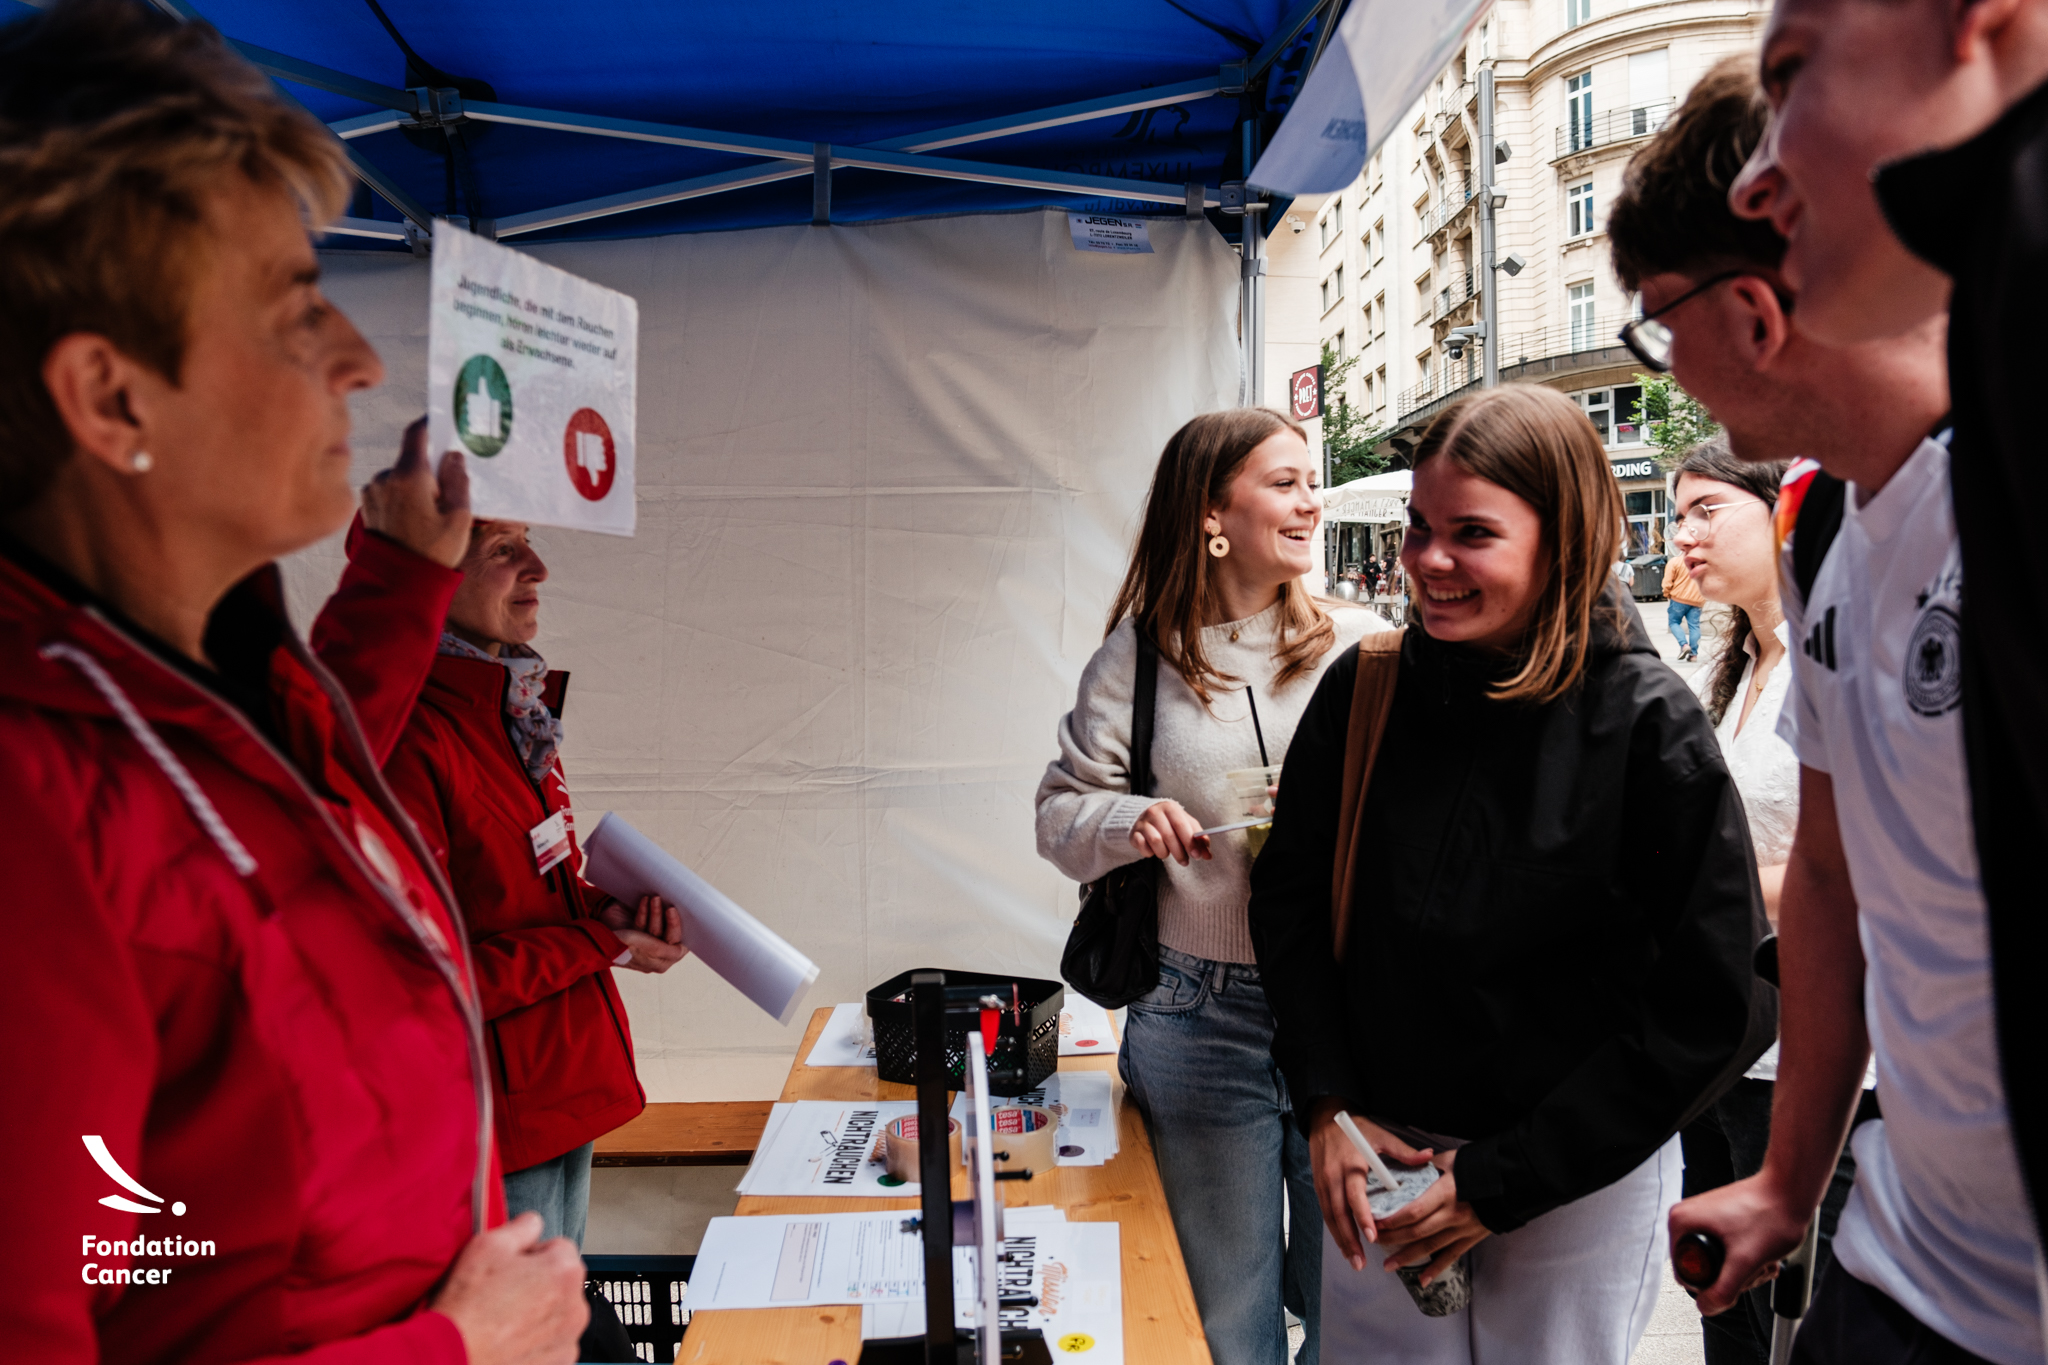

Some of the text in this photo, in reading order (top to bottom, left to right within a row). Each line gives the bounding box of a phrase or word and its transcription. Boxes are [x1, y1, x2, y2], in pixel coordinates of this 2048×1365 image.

[1085, 216, 1123, 227] JEGEN
[458, 274, 614, 340] Jugendliche, die mit dem Rauchen
[453, 298, 504, 326] beginnen,
[536, 325, 569, 345] leichter
[572, 337, 600, 356] wieder
[603, 347, 618, 360] auf
[502, 336, 575, 369] als Erwachsene.
[1298, 384, 1313, 405] PRET
[998, 1110, 1018, 1119] tesa
[998, 1119, 1018, 1127] tesa
[823, 1110, 879, 1184] NICHTRAUCHEN
